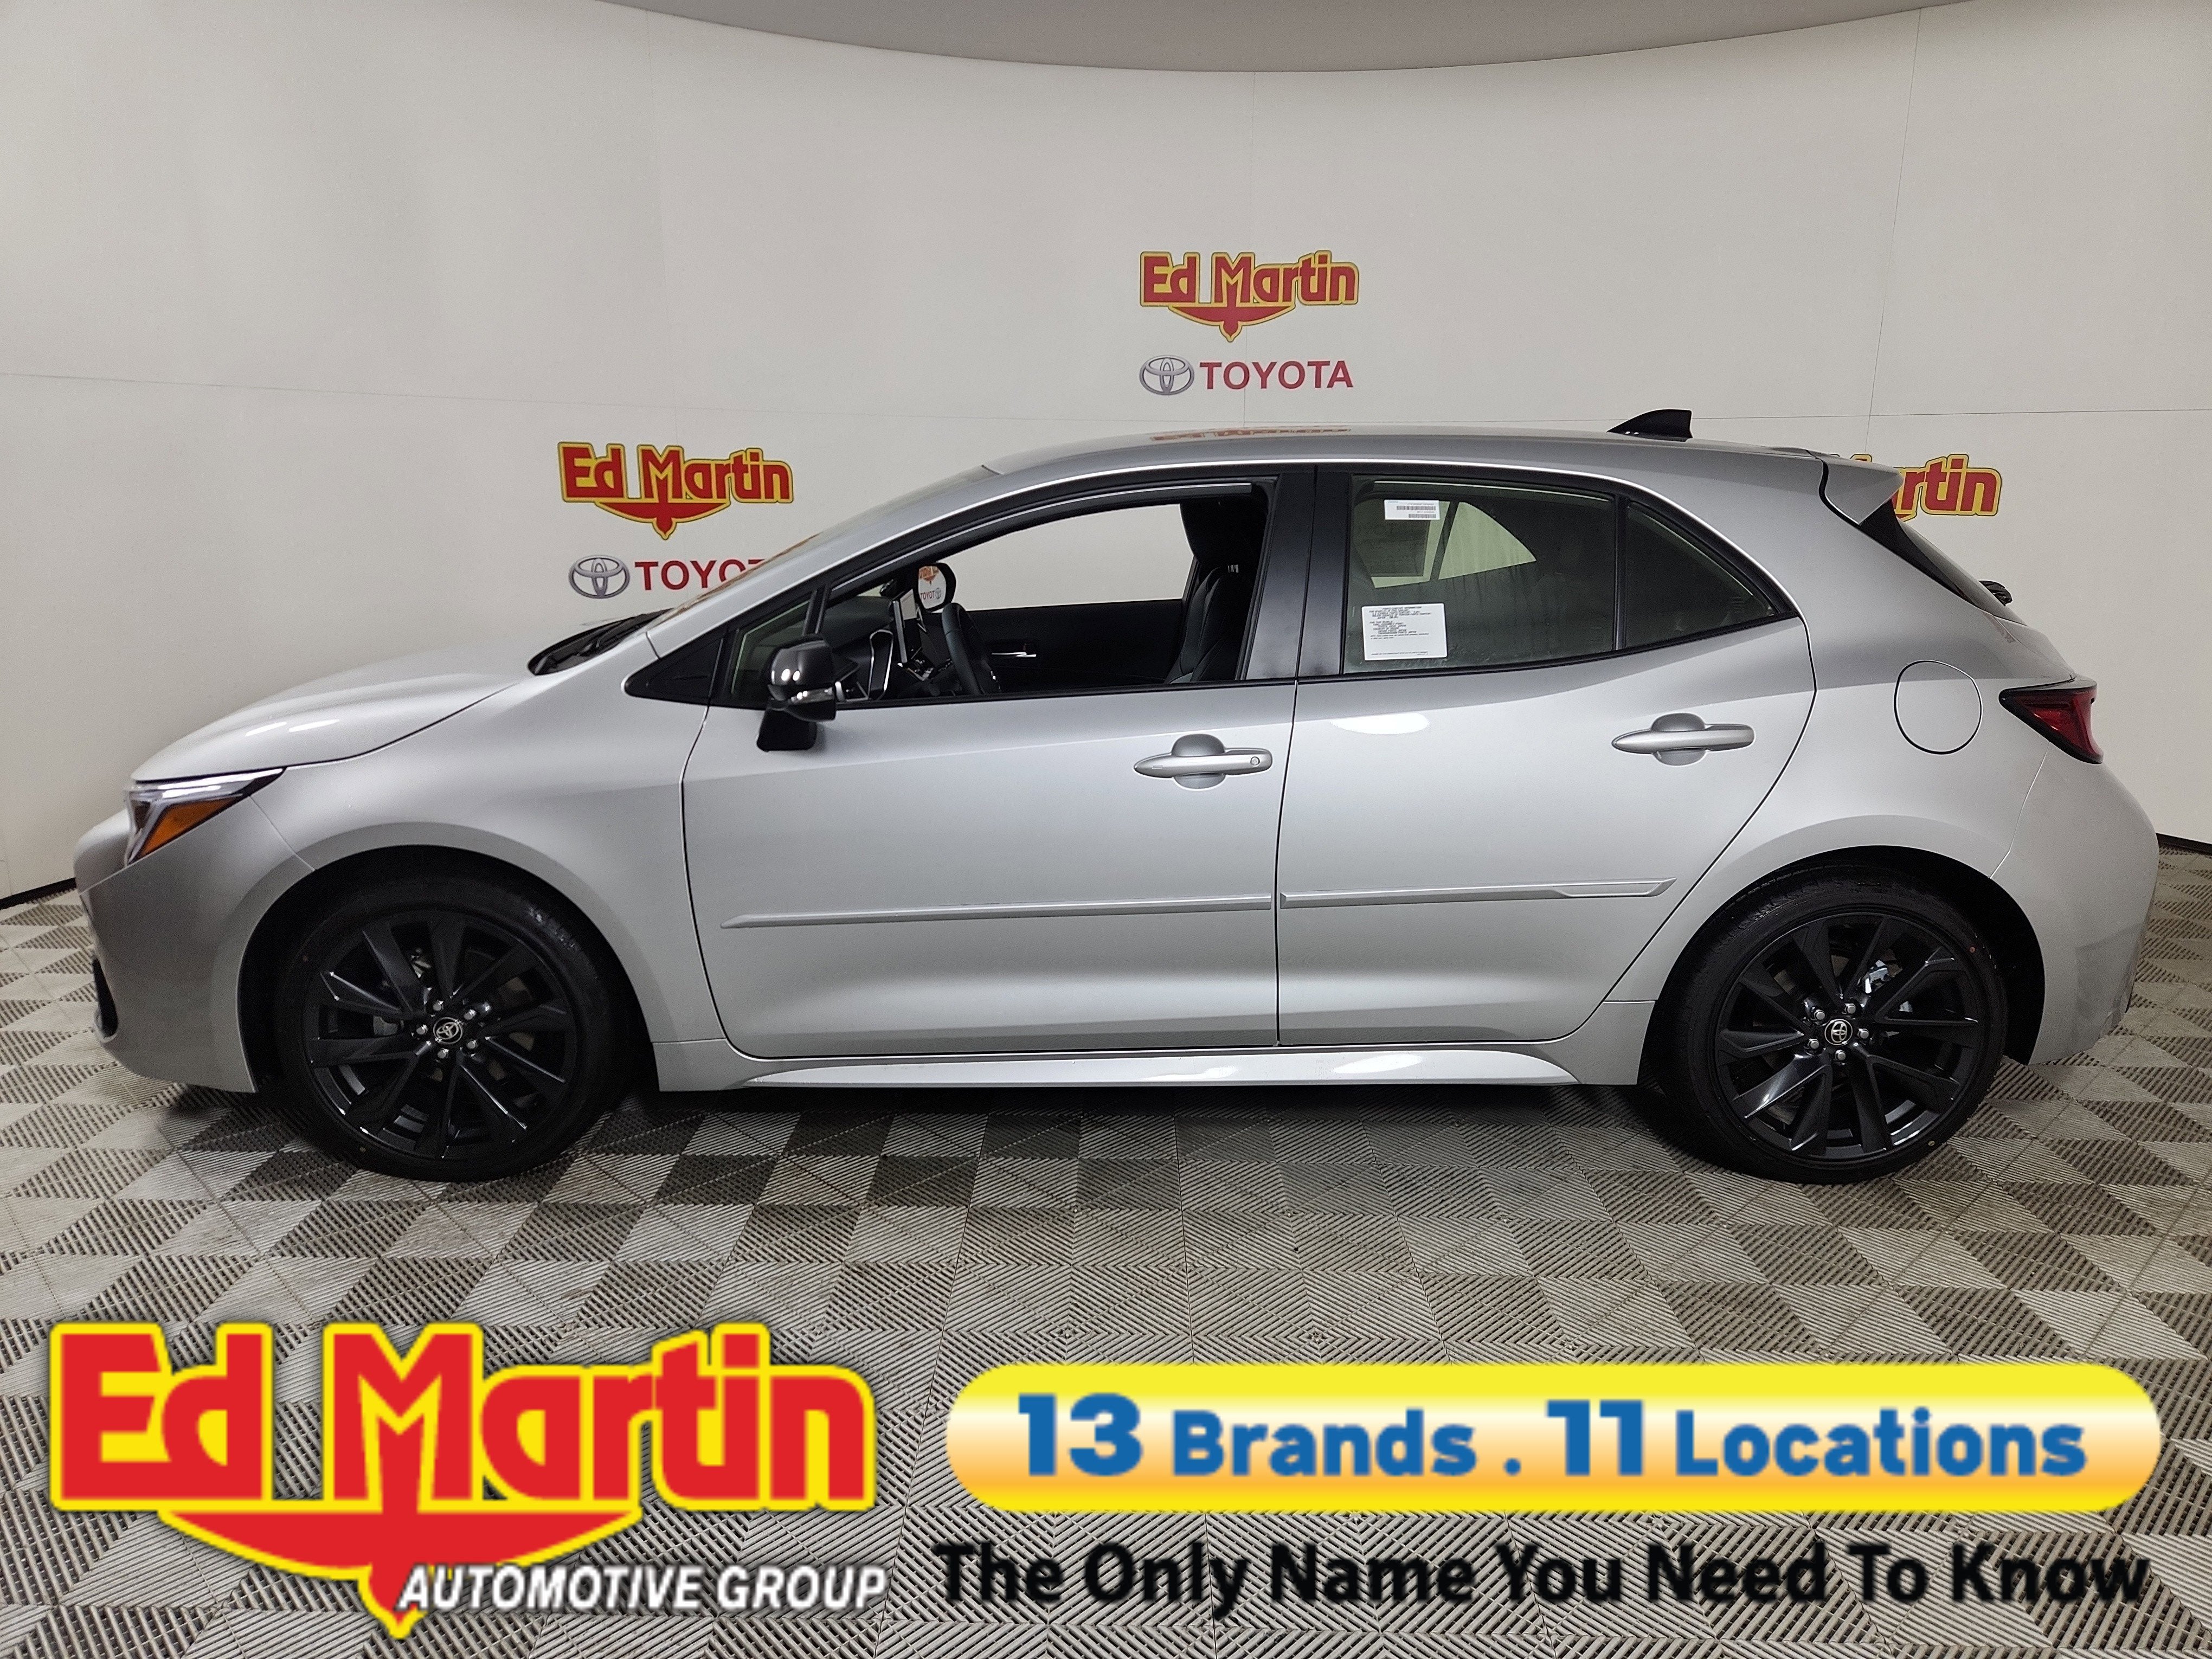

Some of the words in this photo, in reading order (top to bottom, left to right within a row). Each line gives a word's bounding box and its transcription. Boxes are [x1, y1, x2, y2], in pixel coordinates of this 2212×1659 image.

[1140, 252, 1200, 307] Ed
[1211, 250, 1359, 307] Martin
[1199, 360, 1354, 390] TOYOTA
[558, 441, 626, 502] Ed
[637, 444, 794, 503] Martin
[1892, 453, 2002, 516] rtin
[634, 558, 766, 590] TOYO
